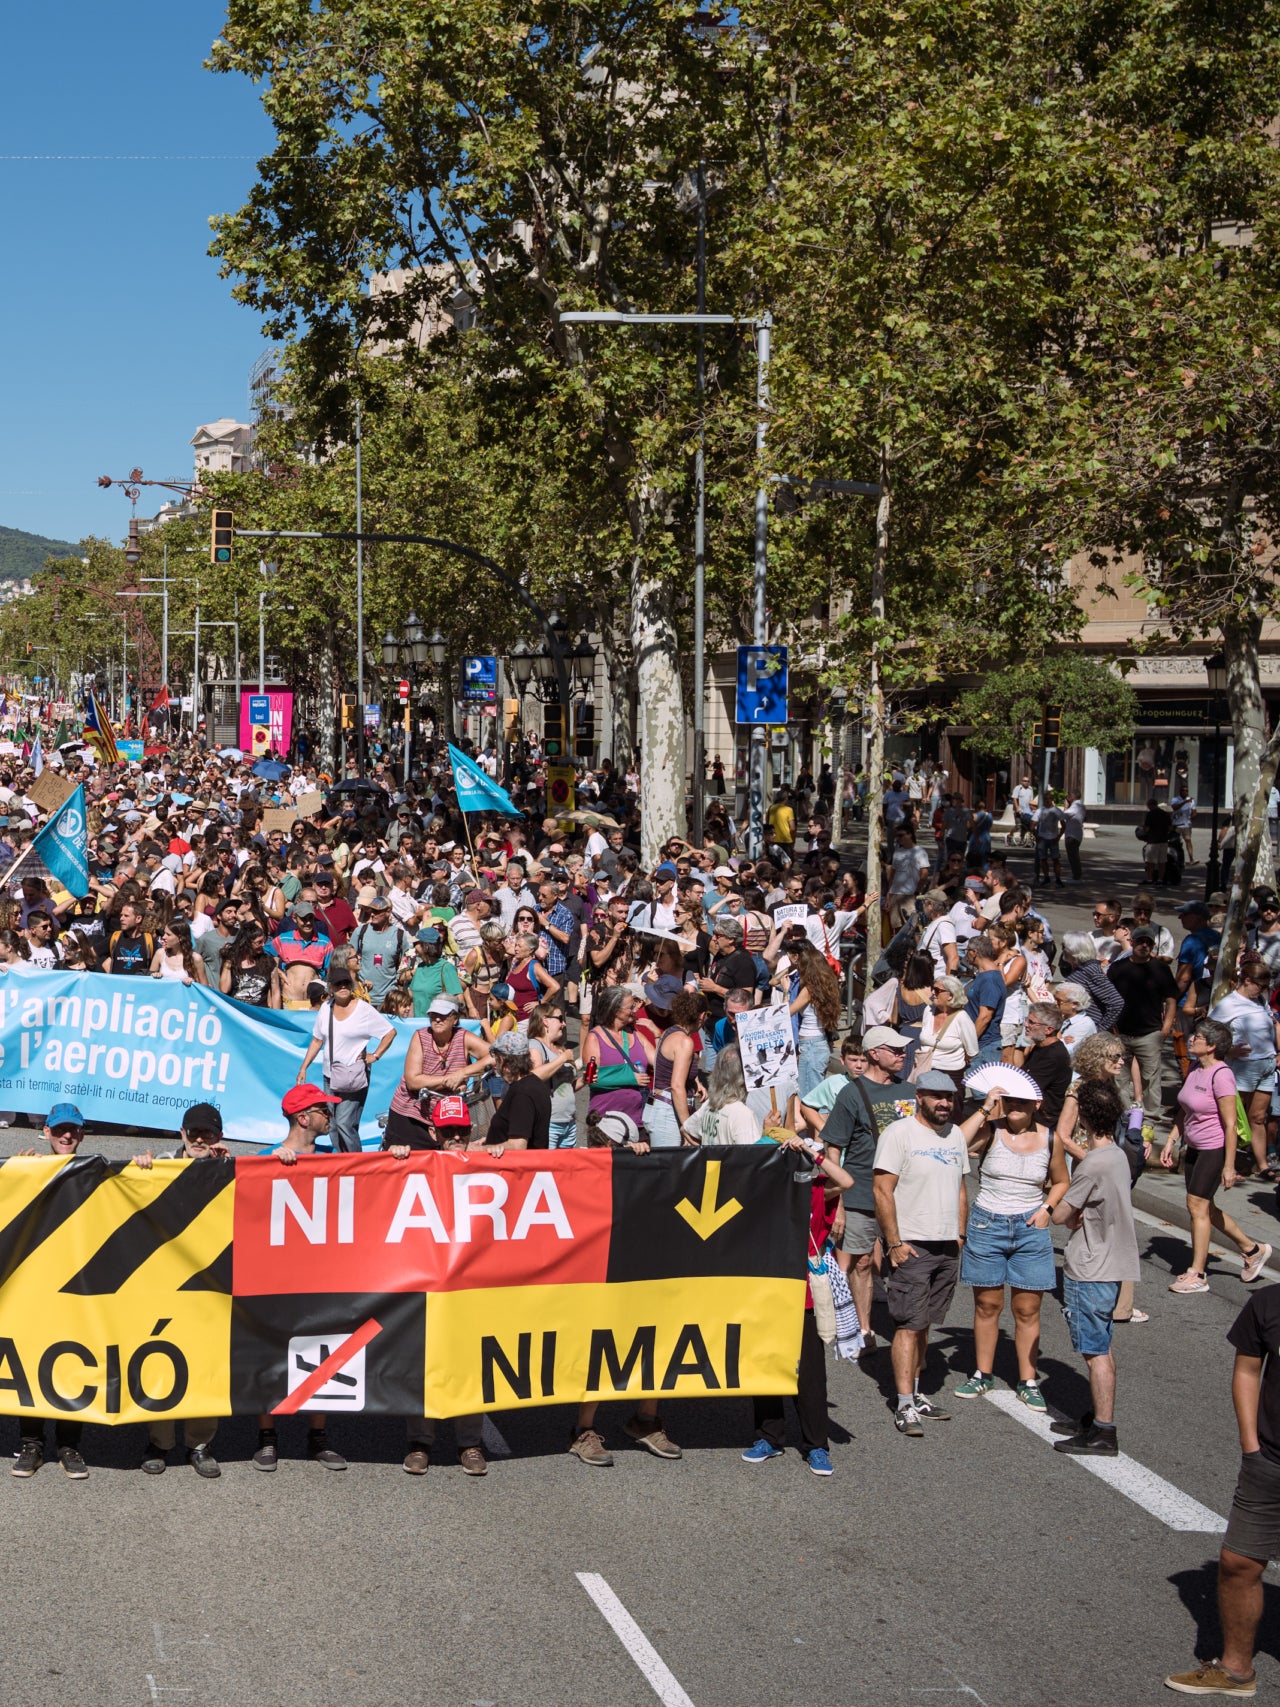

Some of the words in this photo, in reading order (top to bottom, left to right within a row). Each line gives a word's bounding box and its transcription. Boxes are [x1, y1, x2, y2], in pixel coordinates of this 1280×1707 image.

[466, 659, 482, 680] P
[747, 651, 775, 692] P
[745, 1030, 765, 1038] AVIONS
[756, 1039, 785, 1051] DELTA
[16, 1078, 25, 1089] ni
[29, 1079, 62, 1092] terminal
[106, 1086, 116, 1098] ni
[118, 1088, 149, 1103] ciutat
[269, 1177, 355, 1246] NI
[384, 1172, 575, 1244] ARA
[481, 1331, 557, 1404] NI
[586, 1323, 742, 1392] MAI
